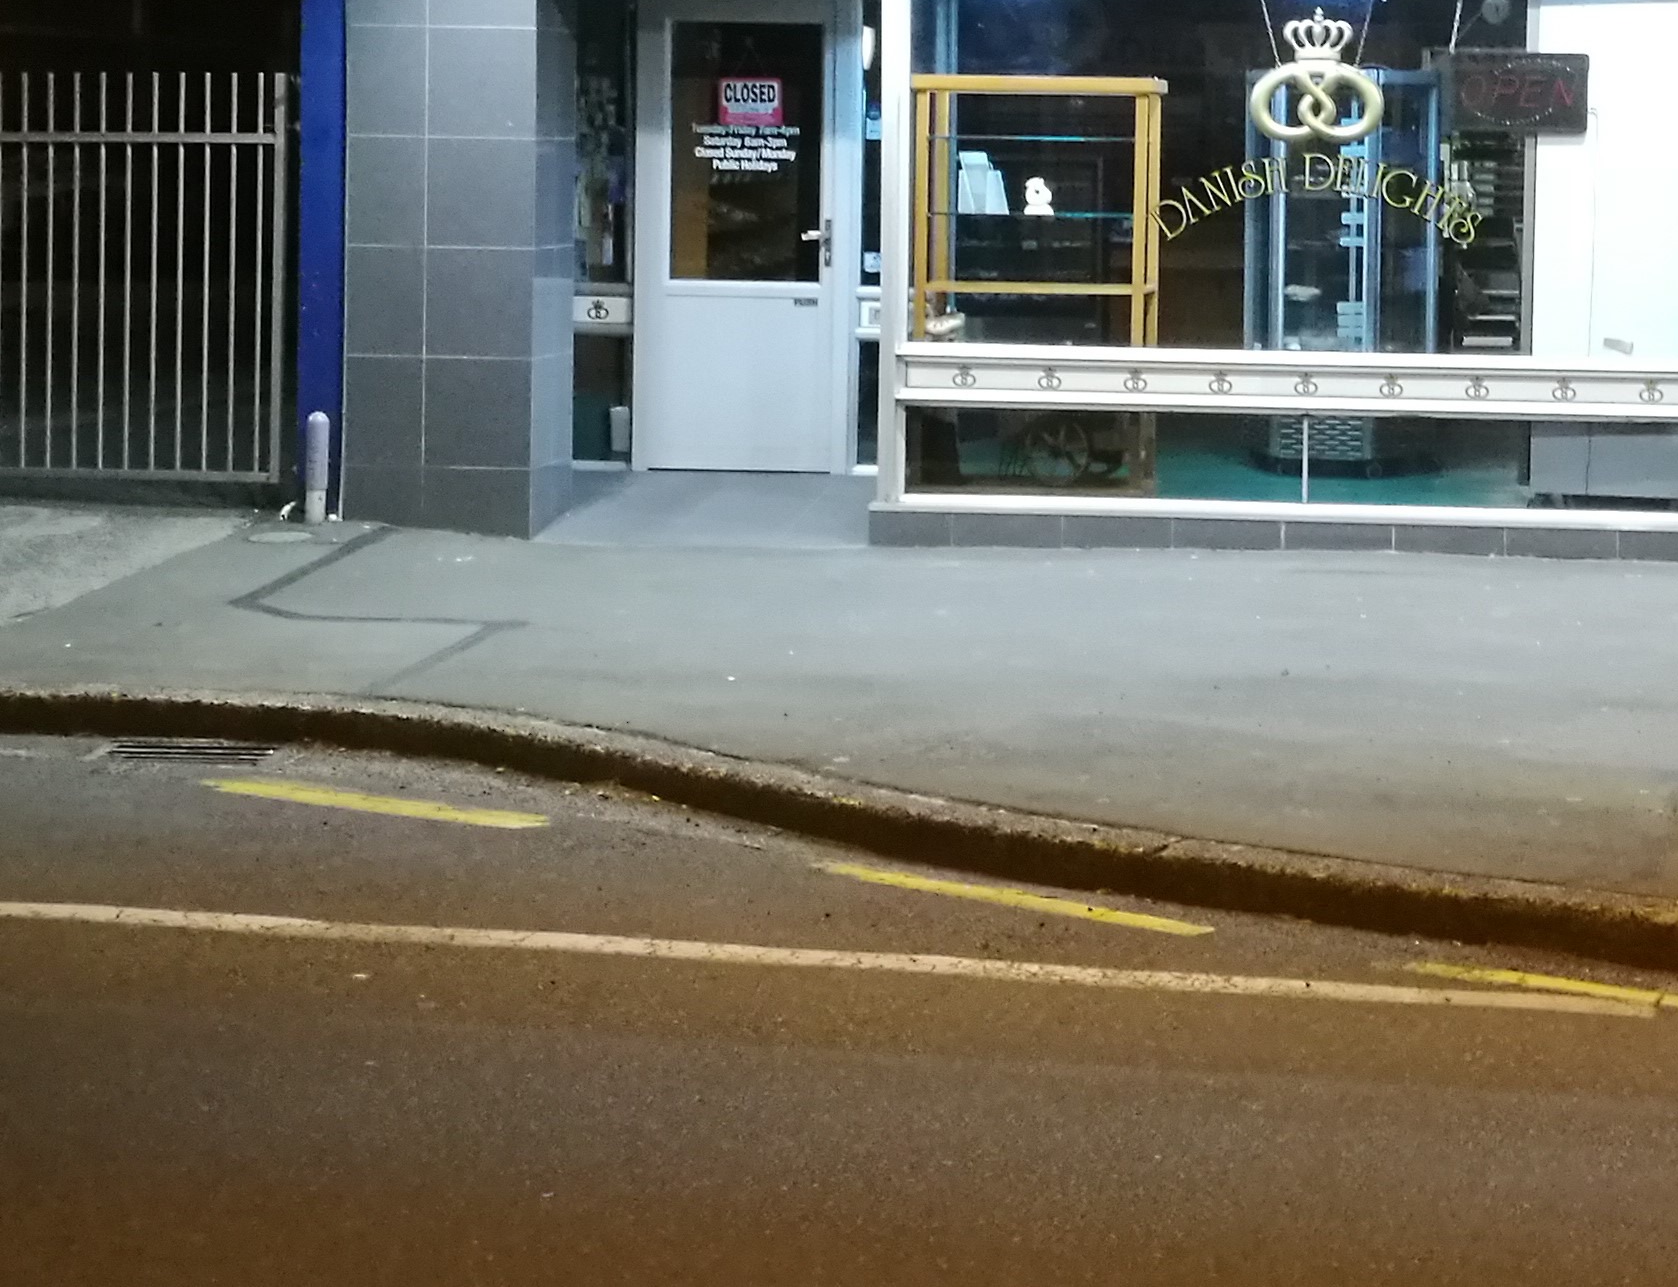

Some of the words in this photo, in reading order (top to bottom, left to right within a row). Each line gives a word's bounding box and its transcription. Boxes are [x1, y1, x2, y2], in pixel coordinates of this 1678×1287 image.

[724, 83, 776, 103] CLOSED
[1460, 74, 1577, 108] OPEN
[703, 135, 743, 148] Saturday
[694, 146, 725, 158] Closed
[712, 159, 740, 171] Public
[741, 160, 779, 173] Holidays
[1150, 157, 1289, 241] DANISH
[1303, 152, 1484, 249] DELIGHTS
